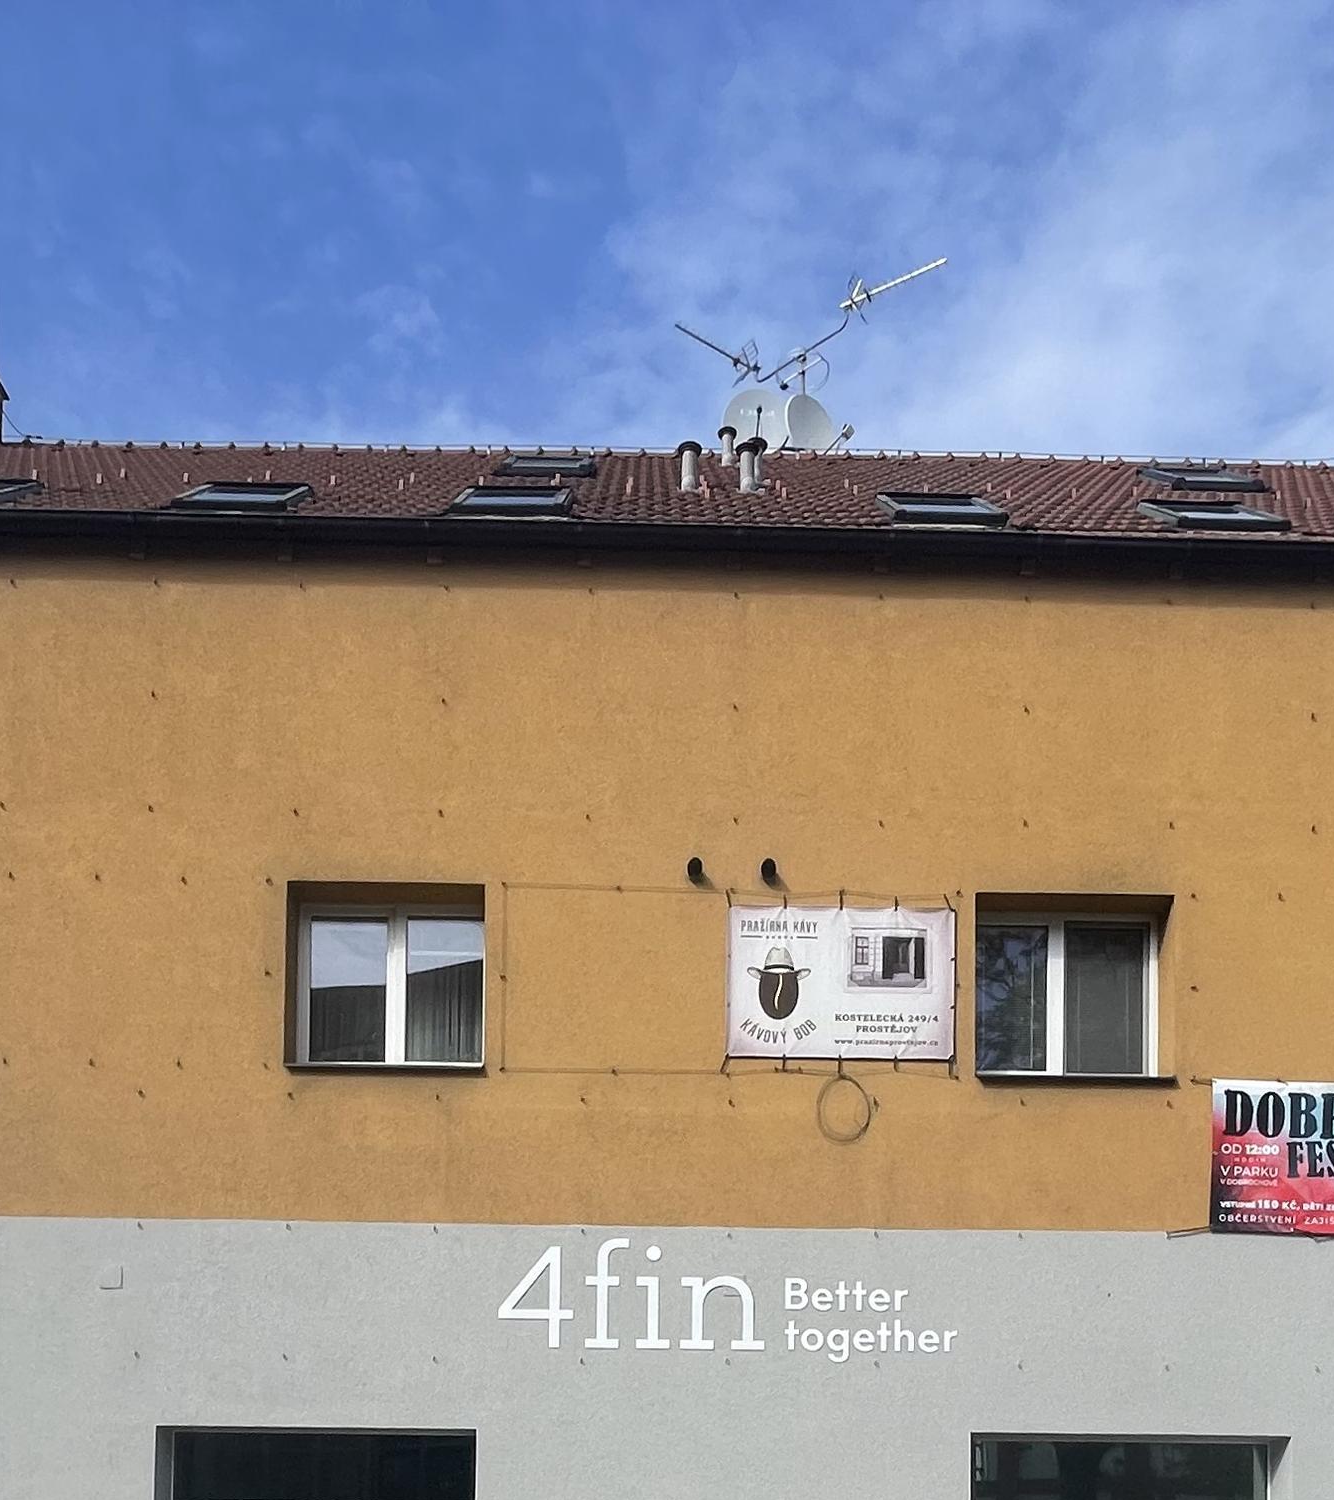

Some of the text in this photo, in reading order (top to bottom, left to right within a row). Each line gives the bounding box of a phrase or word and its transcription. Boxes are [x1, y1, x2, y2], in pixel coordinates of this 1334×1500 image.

[740, 918, 818, 933] PRAŽÍRNA KÁVY
[834, 1013, 939, 1023] KOSTELECKÁ 249/4
[740, 1018, 817, 1044] KÁVOVÝ BOB
[856, 1024, 918, 1033] PROSTĚJOV
[1221, 1143, 1280, 1155] OD 12:00
[1220, 1165, 1279, 1178] V PARKU
[1218, 1212, 1296, 1224] OBČERSTVENÍ
[497, 1237, 909, 1352] 4fin Better
[784, 1319, 959, 1363] together
